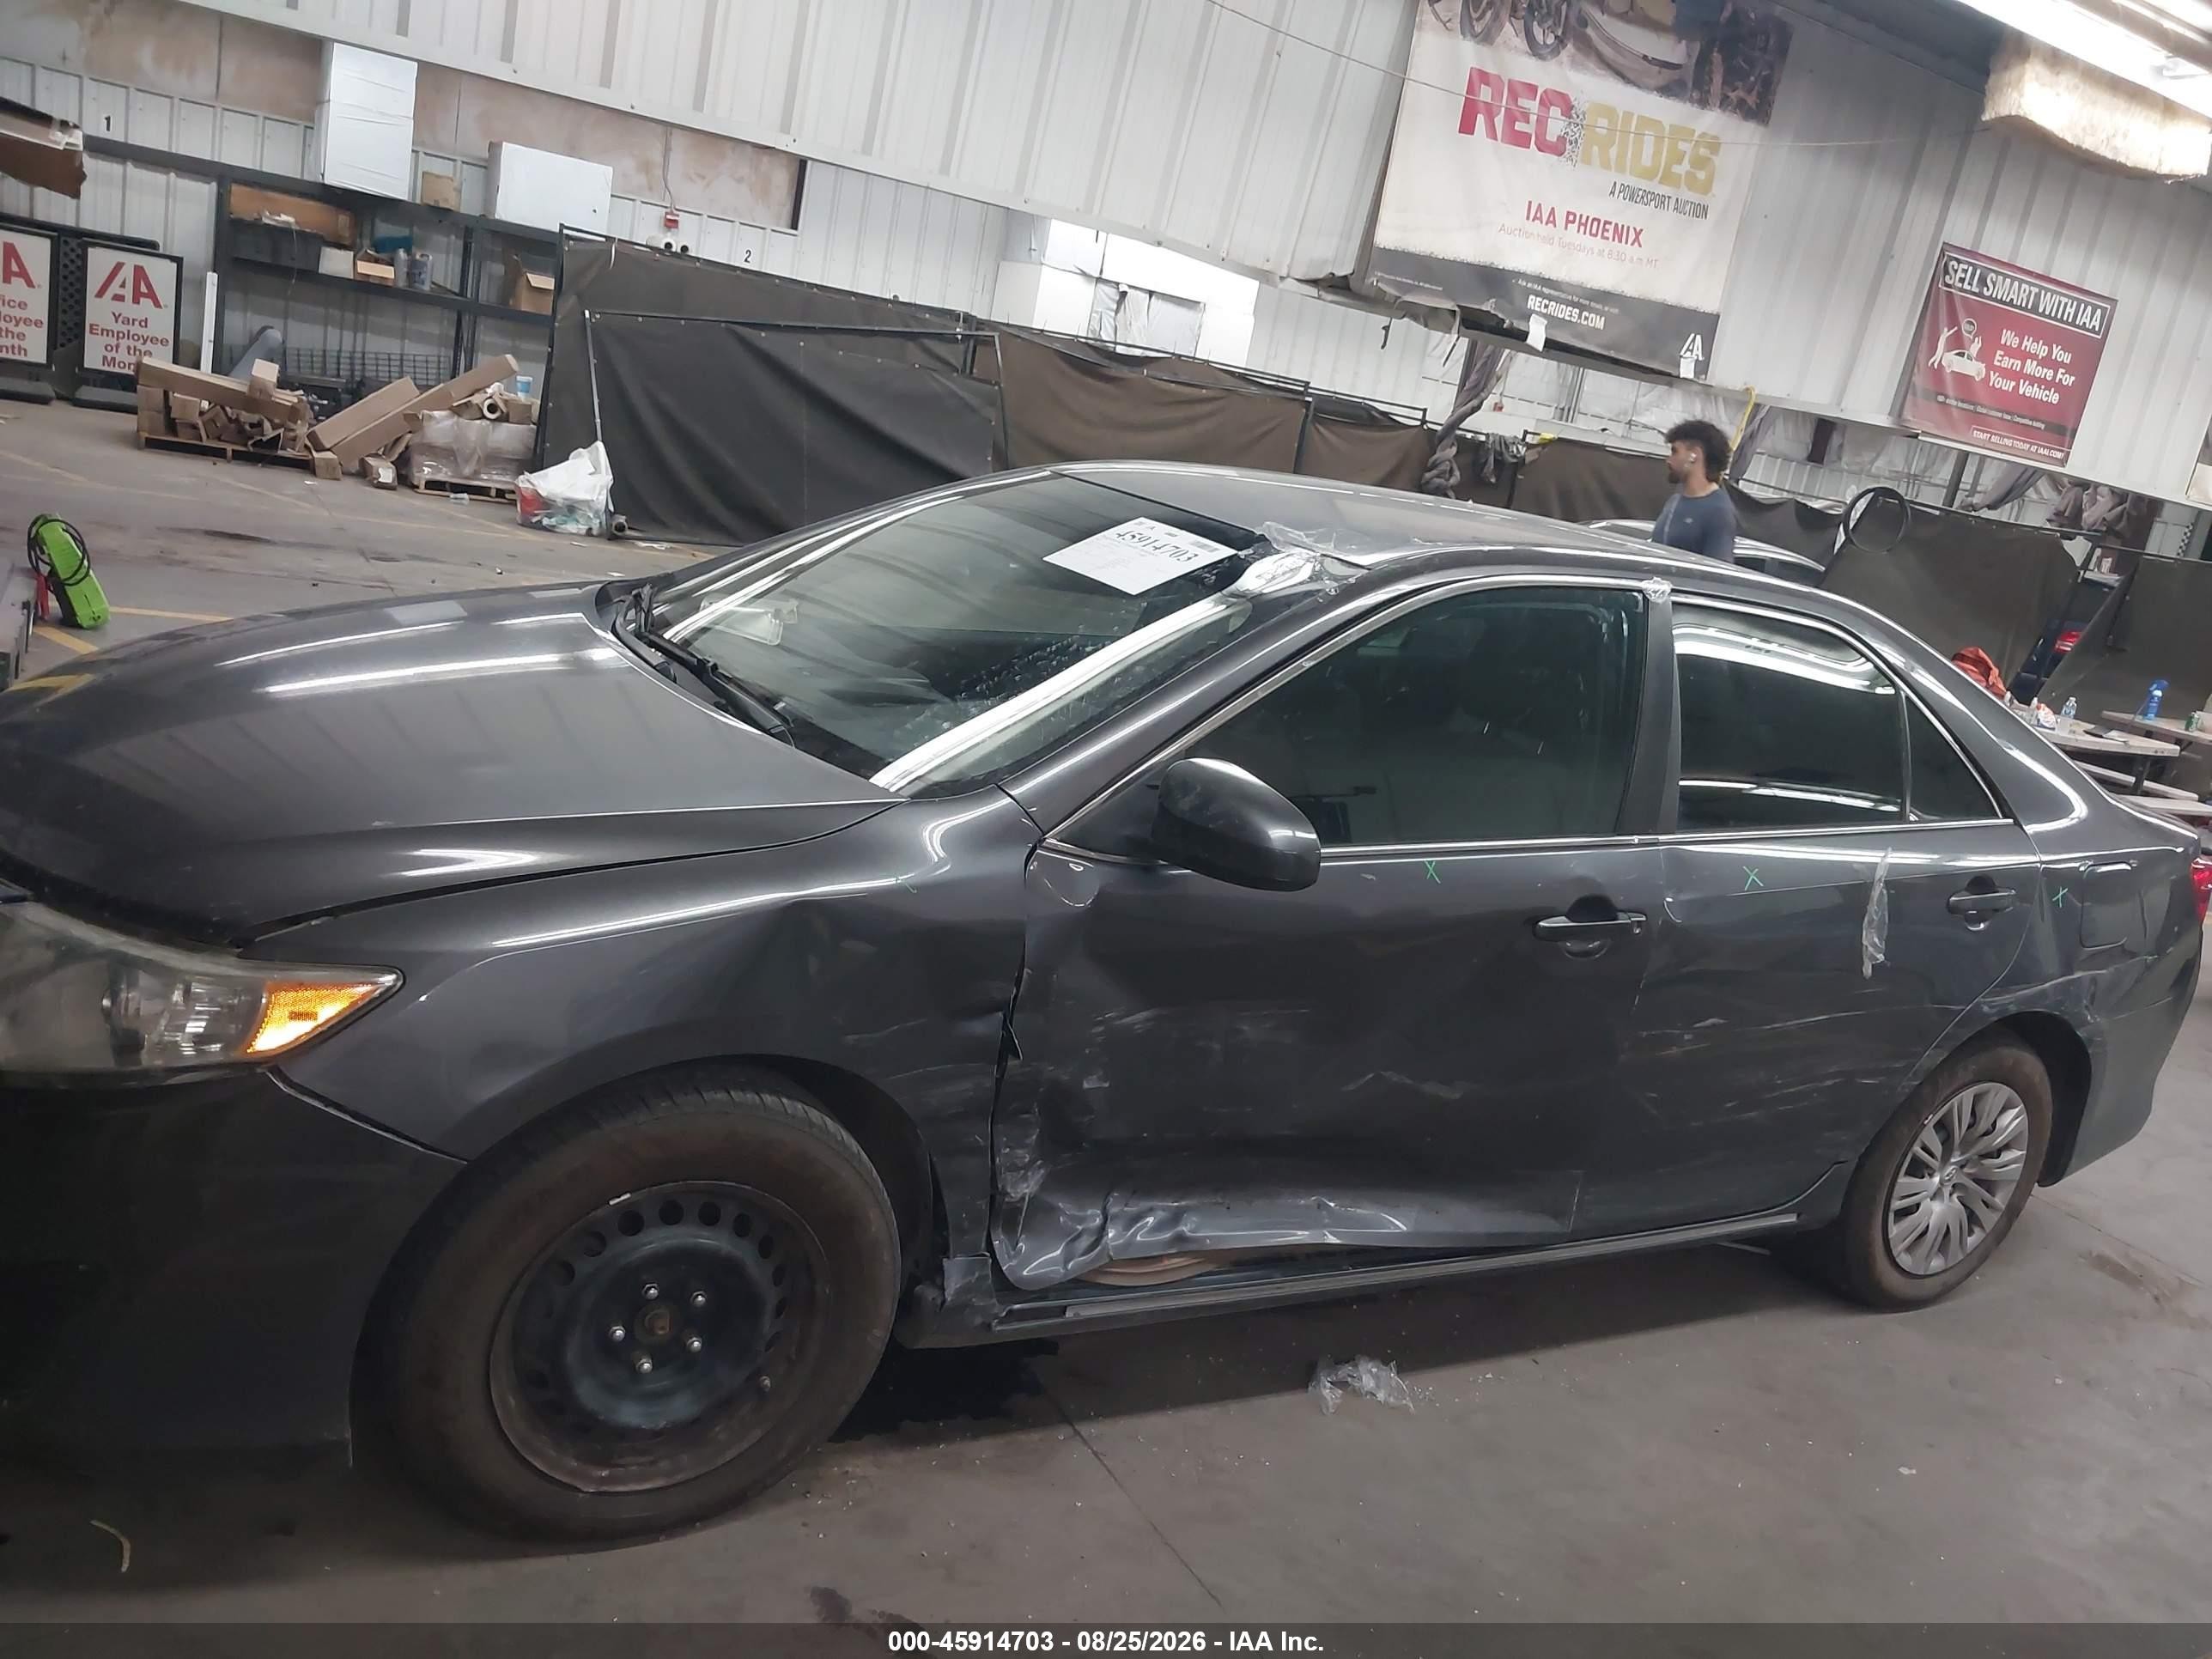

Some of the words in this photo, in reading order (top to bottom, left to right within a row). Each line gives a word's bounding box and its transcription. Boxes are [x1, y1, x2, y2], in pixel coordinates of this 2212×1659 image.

[104, 115, 111, 131] 1
[1458, 66, 1574, 158] REC
[1581, 101, 1722, 197] RIDES
[1608, 180, 1617, 198] A
[1617, 182, 1672, 212] POWERSPORT
[1673, 197, 1709, 220] AUCTION
[1525, 200, 1557, 228] IAA
[1564, 210, 1644, 248] PHOENIX
[744, 249, 751, 264] 2
[0, 295, 27, 310] ice
[1945, 260, 1981, 293] SELL
[1984, 272, 2039, 310] SMART
[2039, 289, 2076, 323] WITH
[2075, 302, 2102, 331] IAA
[111, 311, 148, 328] Yard
[1527, 294, 1606, 330] RECRIDES.COM
[89, 323, 170, 347] Employee
[2000, 329, 2019, 348] We
[2021, 334, 2048, 359] Help
[2051, 343, 2071, 364] You
[0, 343, 27, 357] nth
[102, 355, 137, 373] Mon
[104, 343, 120, 354] of
[126, 345, 152, 358] the
[1994, 349, 2021, 371] Earn
[2023, 358, 2054, 380] More
[2056, 368, 2075, 386] For
[1989, 370, 2016, 392] Your
[2018, 379, 2060, 404] Vehicle
[1973, 430, 1991, 441] START
[1115, 530, 1199, 562] 45914703
